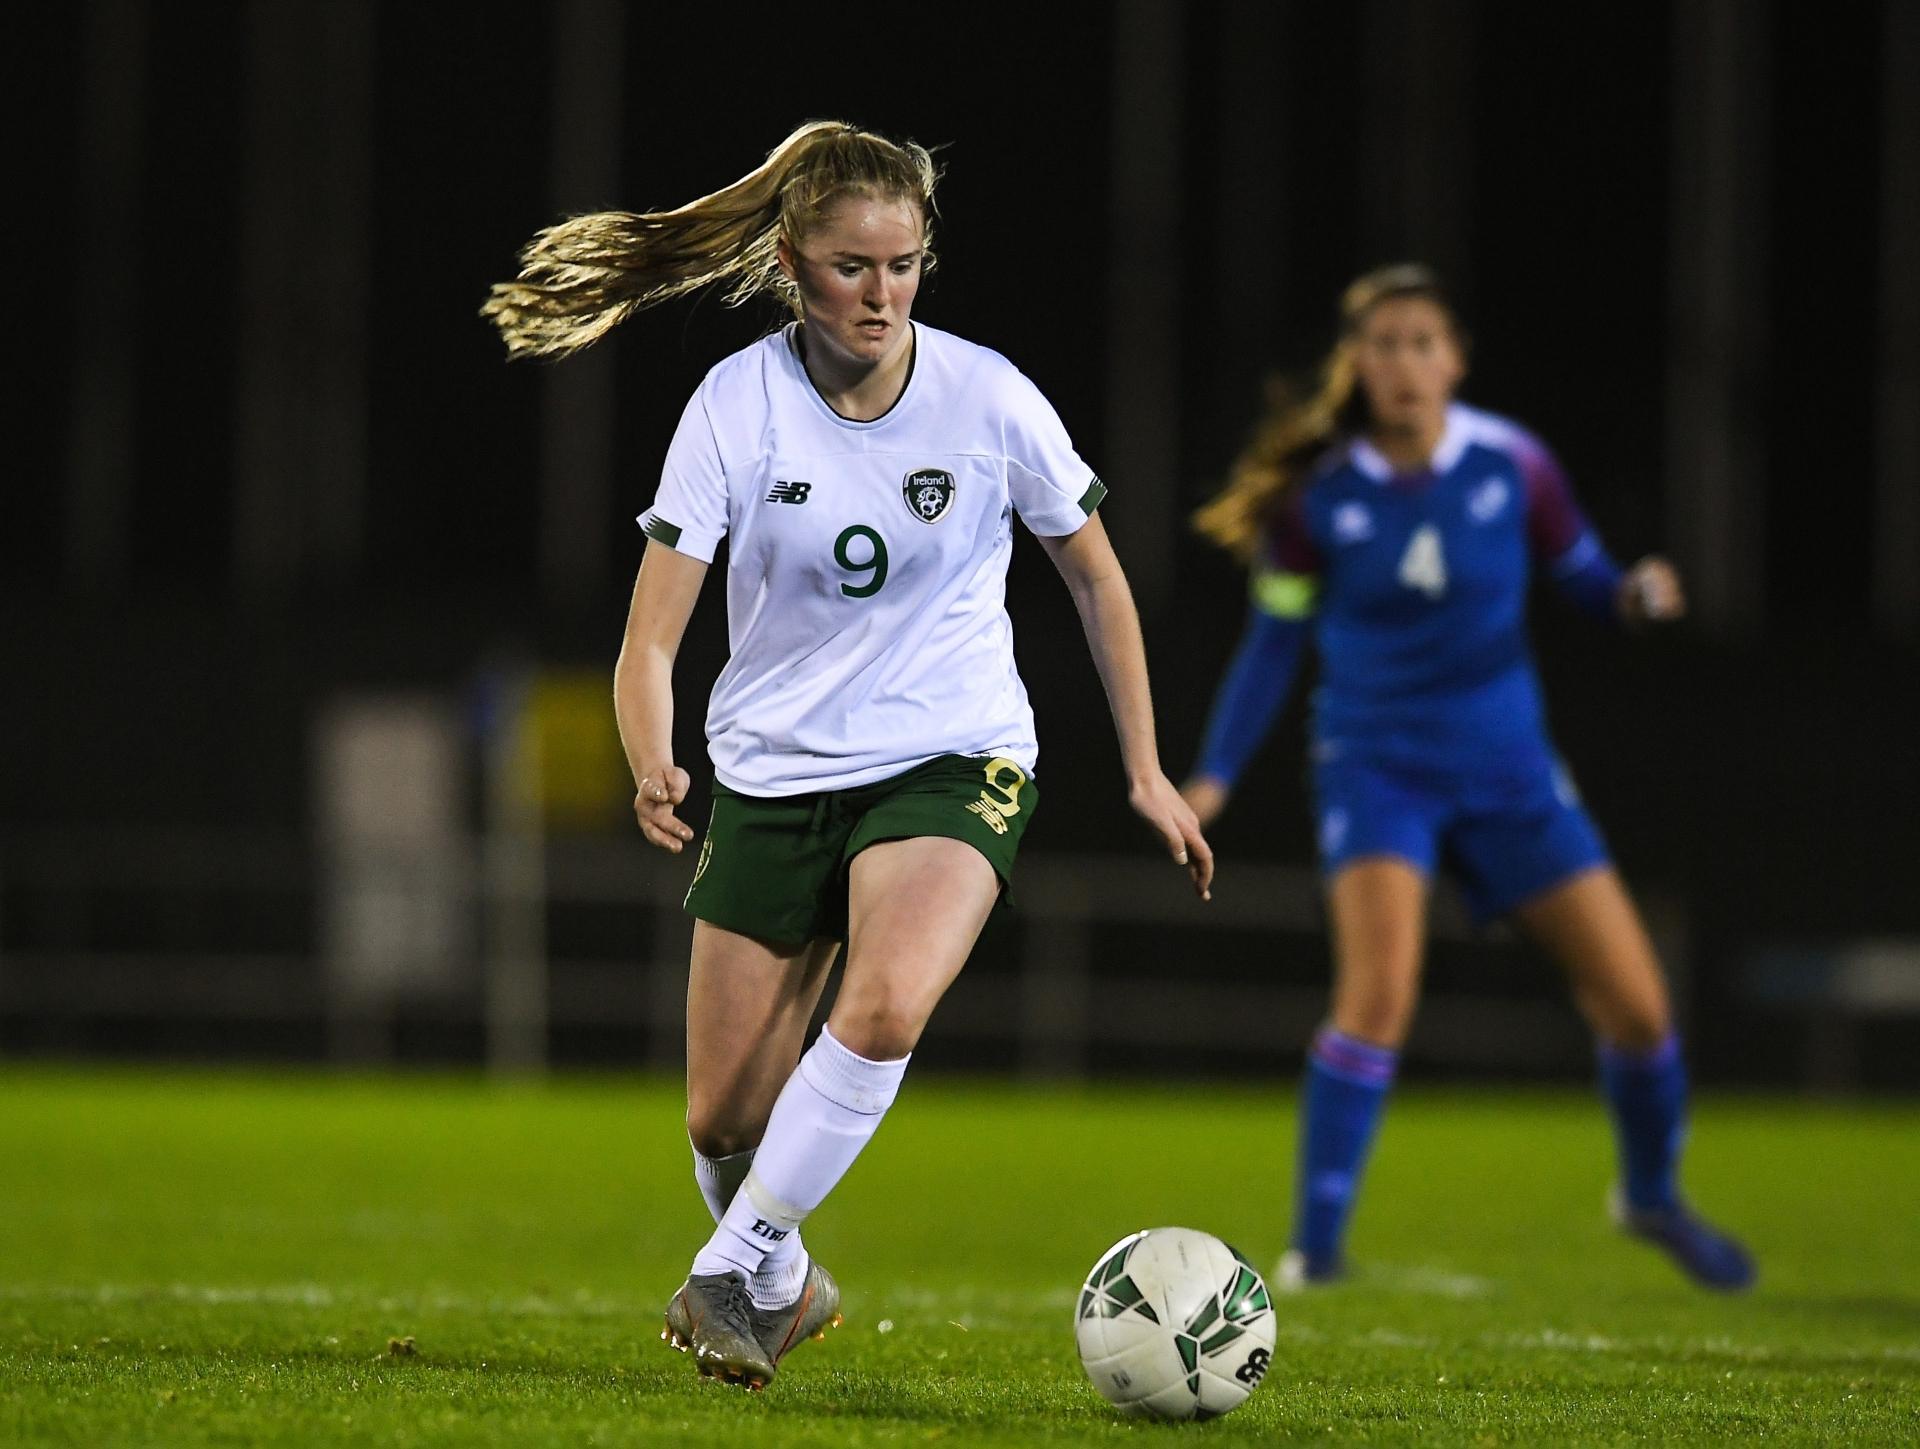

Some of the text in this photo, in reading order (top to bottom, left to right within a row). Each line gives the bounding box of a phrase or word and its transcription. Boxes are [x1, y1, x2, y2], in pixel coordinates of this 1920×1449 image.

[913, 475, 945, 486] Ireland
[834, 524, 889, 599] 9
[1399, 523, 1446, 597] 4
[981, 757, 1026, 818] 9
